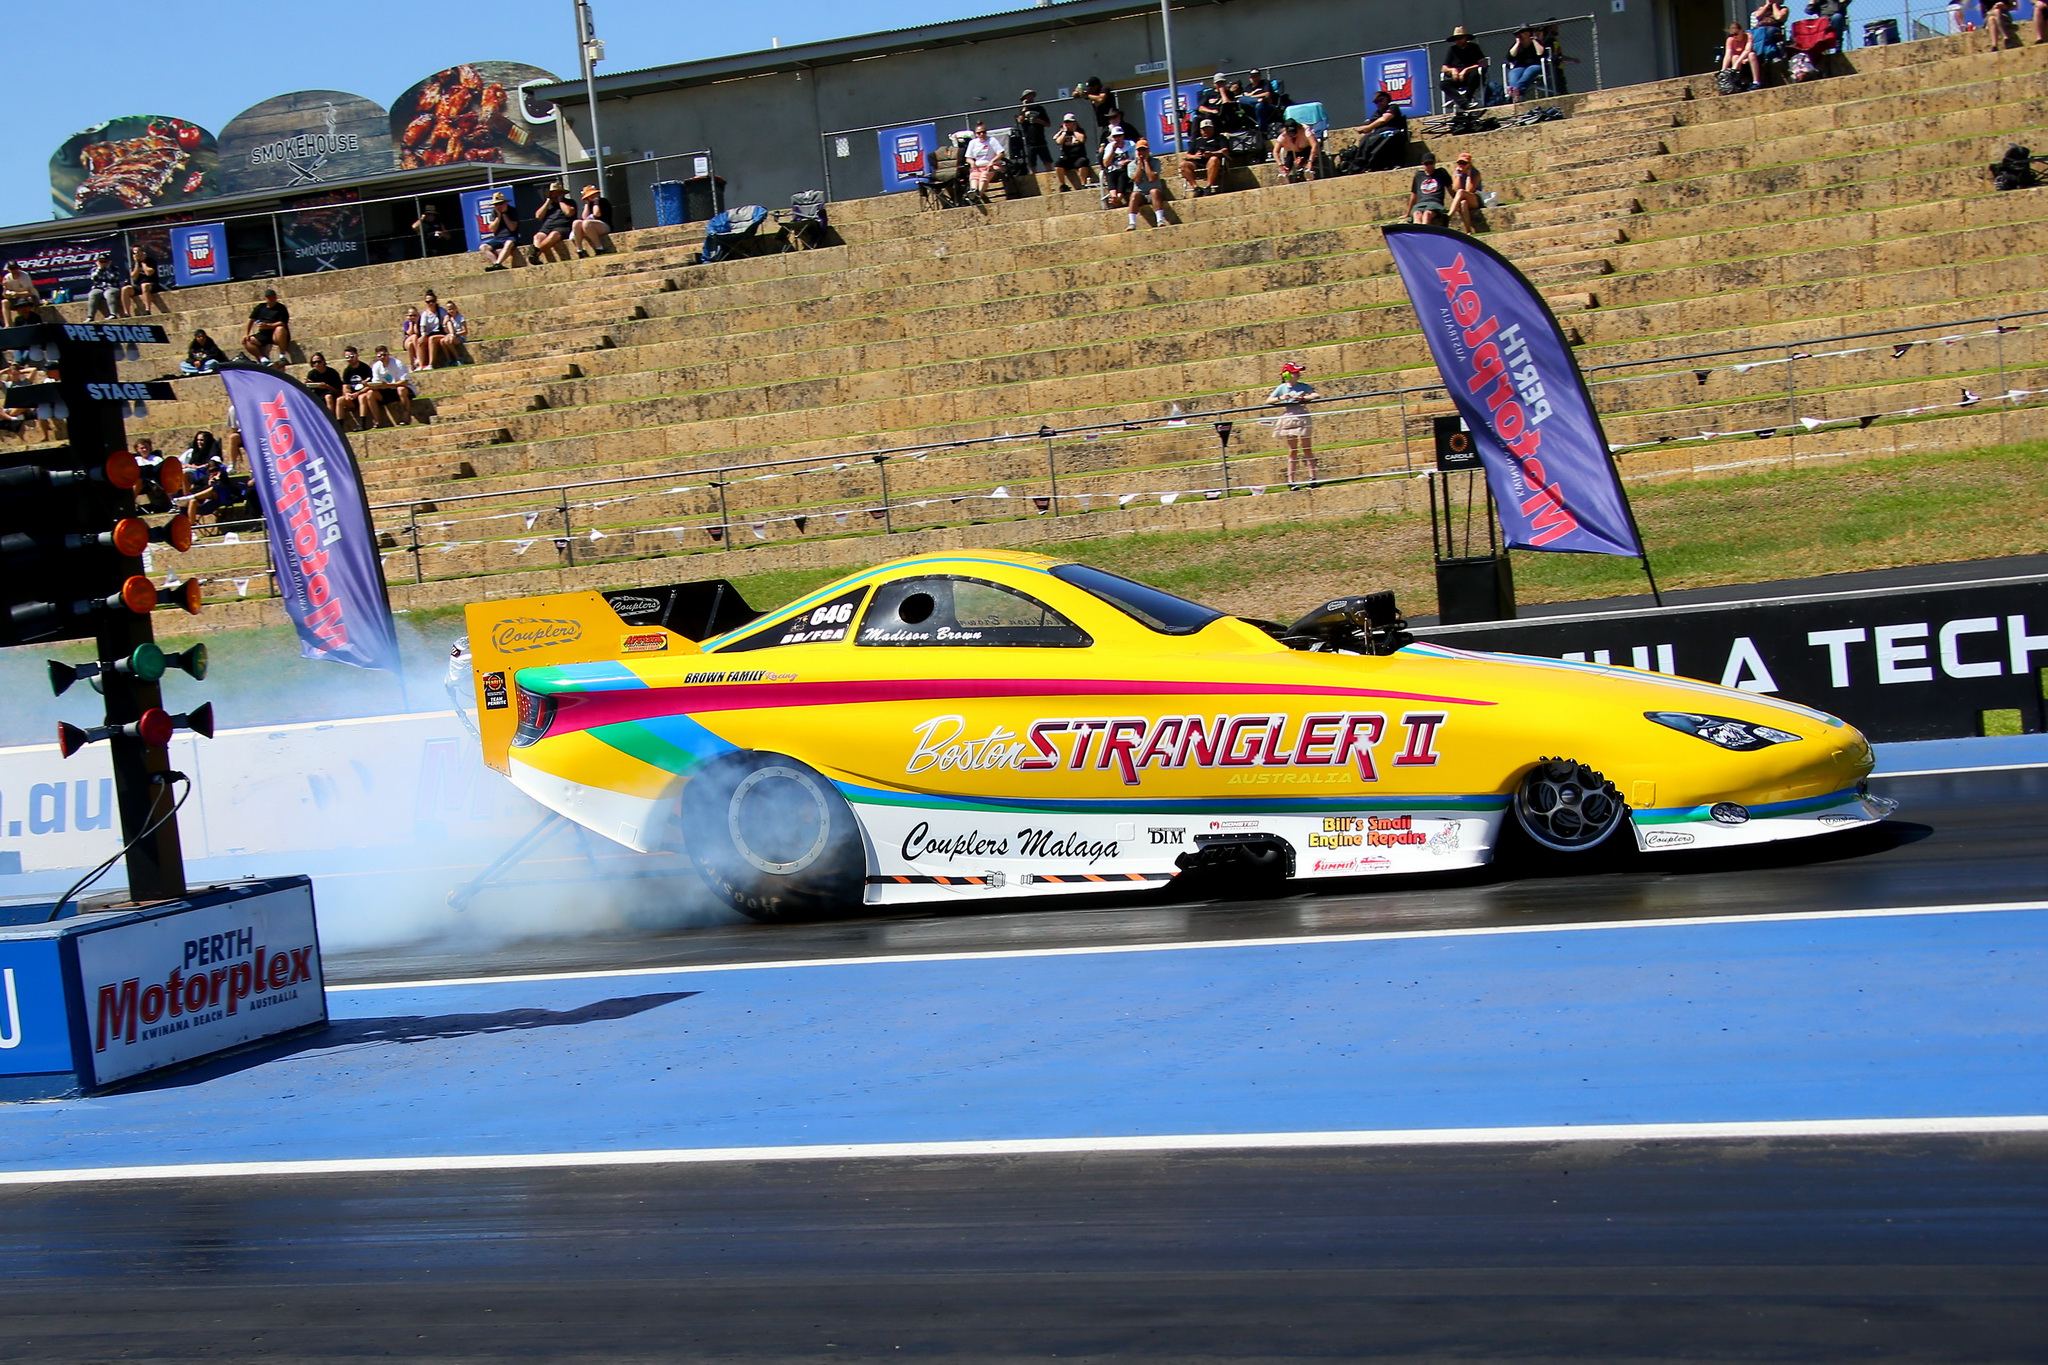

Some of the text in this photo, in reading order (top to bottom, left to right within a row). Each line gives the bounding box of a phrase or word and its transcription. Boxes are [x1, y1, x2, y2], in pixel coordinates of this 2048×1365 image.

[1385, 78, 1406, 91] TOP
[251, 133, 359, 164] SMOKEHOUSE
[899, 150, 918, 163] TOP
[190, 248, 209, 260] TOP
[295, 241, 357, 258] SMOKEHOUSE
[63, 325, 156, 342] PRE-STAGE
[86, 383, 152, 400] STAGE
[810, 603, 854, 626] 646
[499, 624, 576, 645] Couplers
[864, 626, 982, 641] Madison Brown
[1807, 614, 2048, 688] TECH
[684, 672, 726, 684] BROWN
[726, 670, 767, 682] FAMILY
[905, 710, 1448, 785] Boston STRANGLER II
[1227, 772, 1353, 785] AUSTRALIA
[0, 778, 113, 836] .au
[1323, 815, 1412, 832] Bill's Small
[901, 821, 1120, 866] Couplers Malaga
[1308, 830, 1427, 850] Engine Repairs
[1649, 833, 1692, 844] Couplers
[184, 926, 253, 970] PERTH
[95, 944, 314, 1054] Motorplex
[142, 989, 298, 1041] KWINANA BEACH AUSTRALIA
